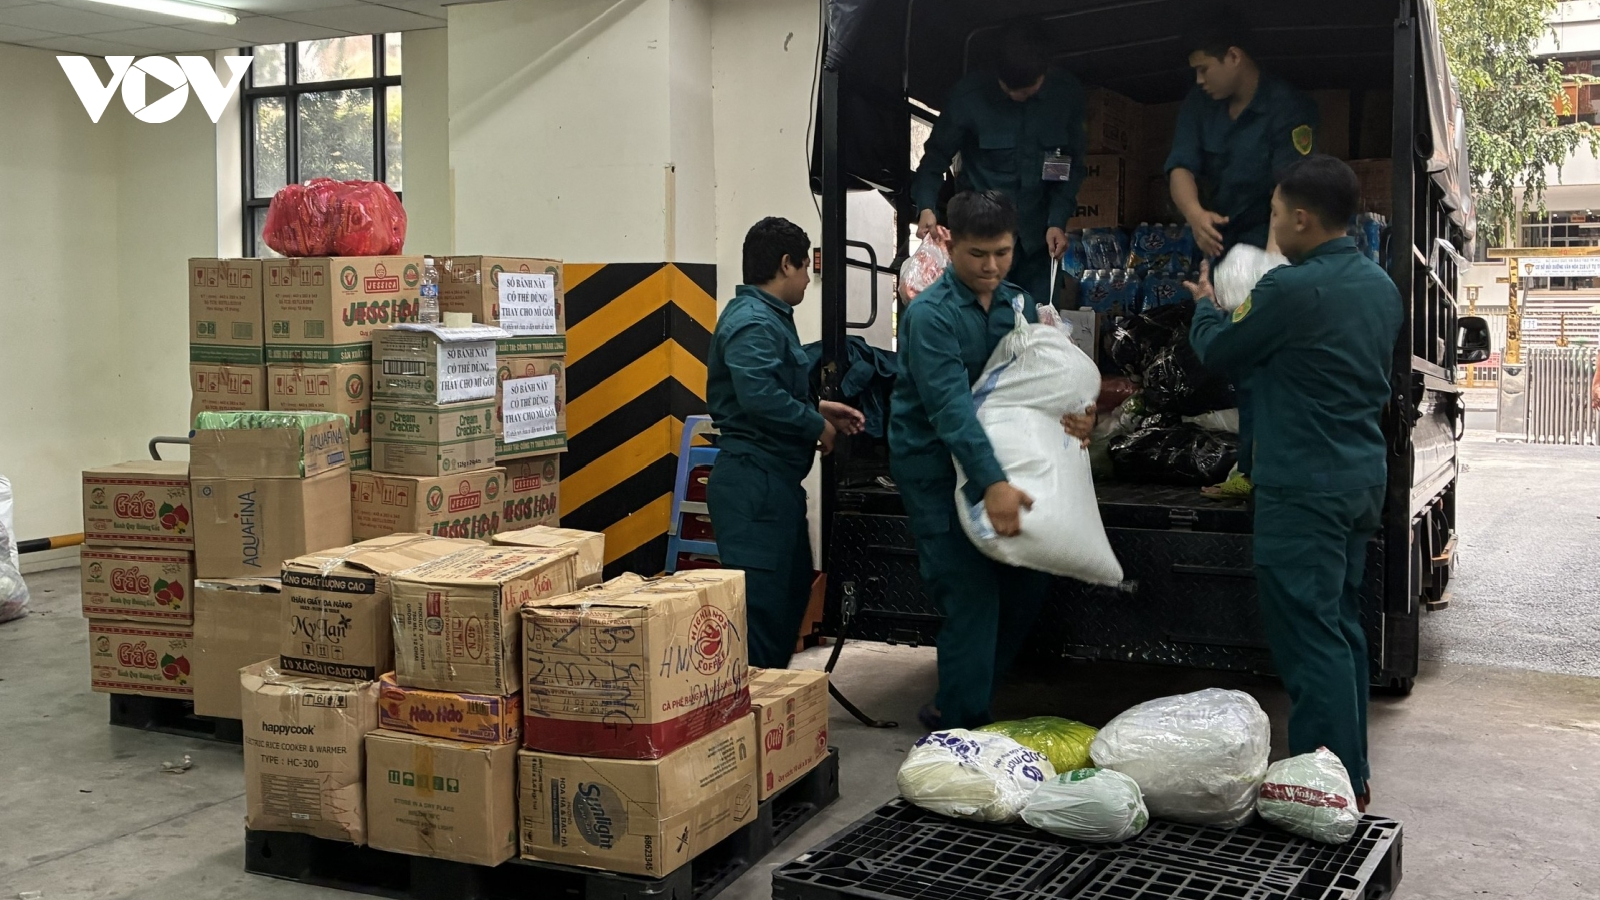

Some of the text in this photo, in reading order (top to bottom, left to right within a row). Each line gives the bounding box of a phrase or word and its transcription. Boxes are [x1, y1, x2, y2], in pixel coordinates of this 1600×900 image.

[368, 281, 397, 290] JESSICA
[507, 277, 546, 289] SỐ BÁNH NÀY
[507, 291, 547, 303] CÓ THỂ DÙNG
[342, 298, 420, 326] JESSICA
[502, 306, 553, 316] THAY CHO MÌ GÓI
[447, 346, 488, 359] SỐ BÁNH NÀY
[447, 361, 489, 374] CÓ THỂ DÙNG
[441, 376, 494, 391] THAY CHO MÌ GÓI
[511, 380, 548, 394] SỐ BÁNH NÀY
[510, 396, 548, 408] CÓ THỂ DÙNG
[394, 412, 416, 422] Cream
[460, 414, 478, 426] Cream
[505, 406, 556, 424] THAY CHO MÌ GÓI
[390, 421, 420, 432] Crackers
[456, 424, 482, 437] Crackers
[309, 424, 344, 450] AQUAFINA
[114, 490, 156, 519] Gấc
[452, 496, 478, 509] JESSICA
[503, 492, 556, 522] ESSICA
[238, 490, 261, 568] AQUAFINA
[110, 566, 151, 595] Gấc
[301, 576, 320, 586] CHẤT
[347, 582, 366, 592] CAO
[692, 609, 728, 641] HIGHLANDS
[117, 641, 158, 669] Gấc
[662, 702, 671, 711] CÀ
[262, 721, 314, 735] happycook
[266, 741, 280, 750] RICE
[281, 743, 307, 752] COOKER
[260, 754, 279, 764] TYPE
[287, 759, 319, 768] HC-300
[578, 782, 613, 850] Sunlight
[644, 835, 653, 870] 68623345
